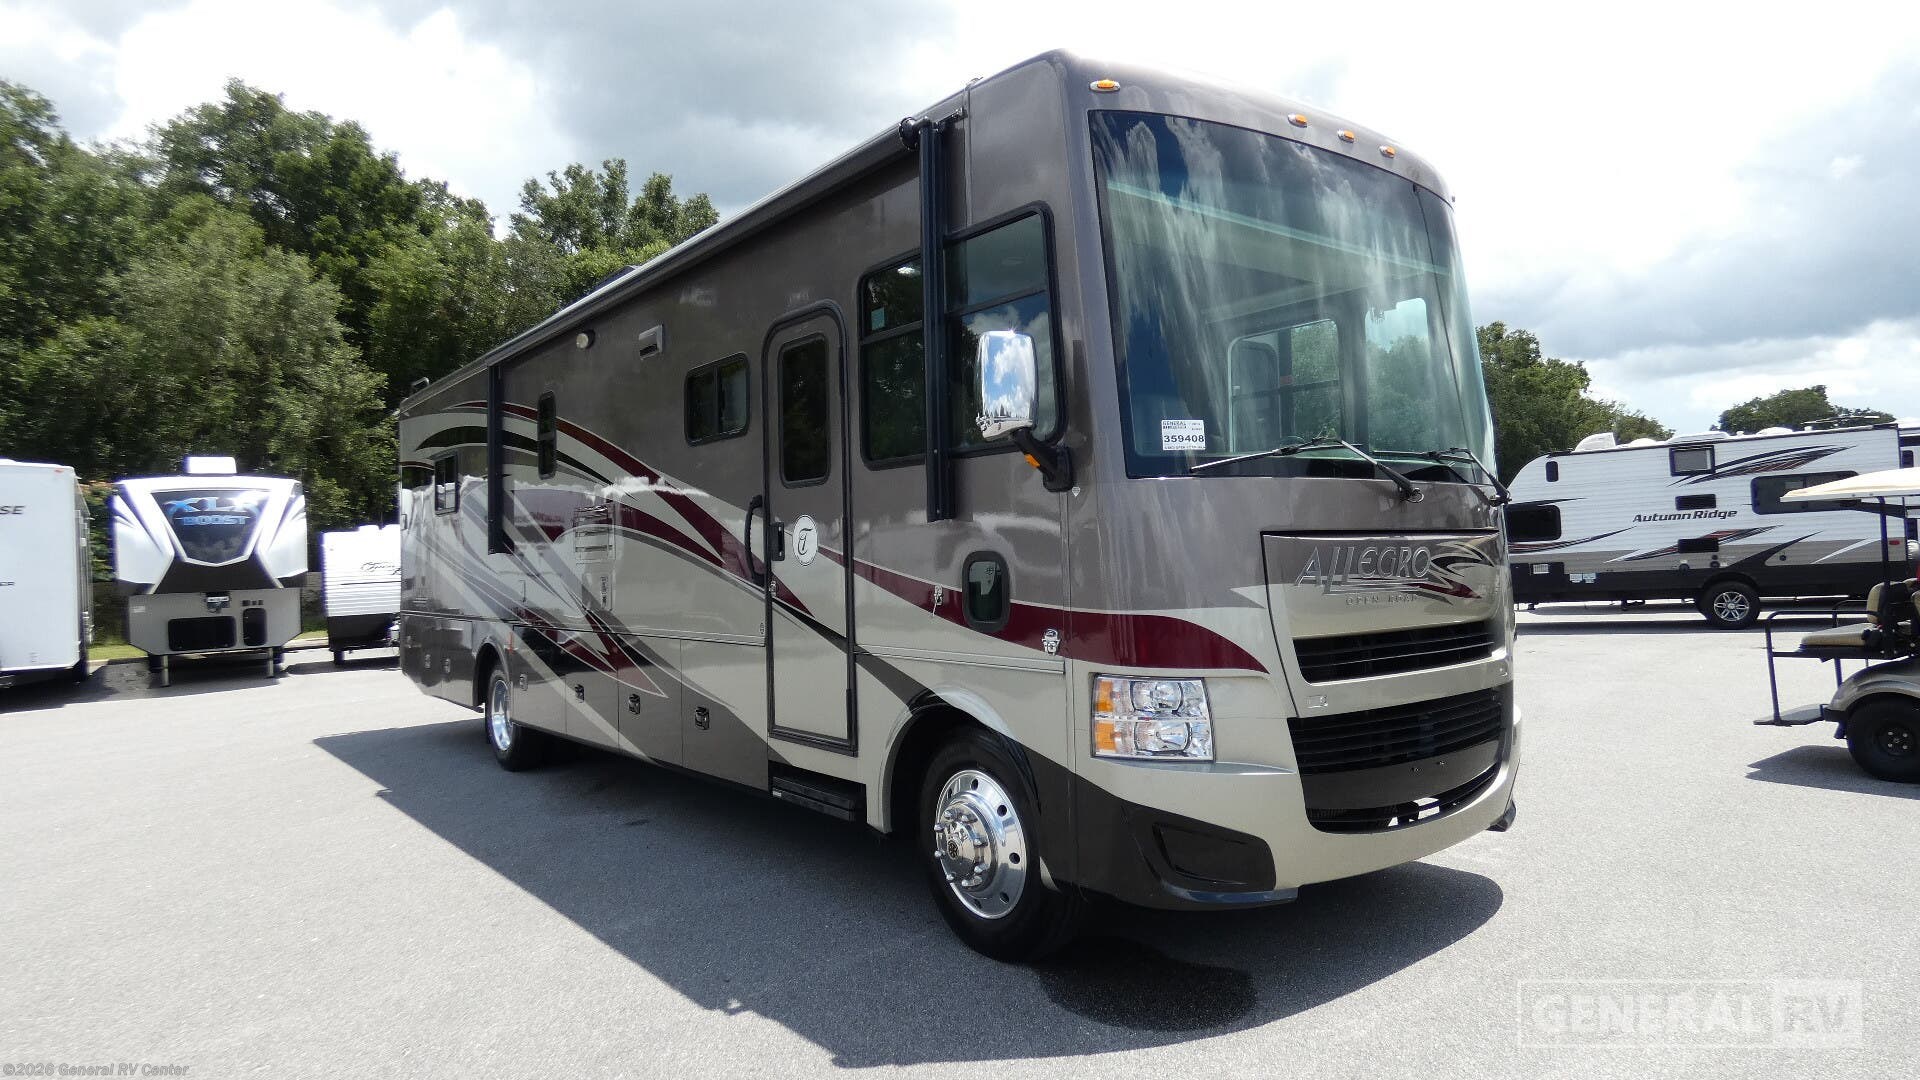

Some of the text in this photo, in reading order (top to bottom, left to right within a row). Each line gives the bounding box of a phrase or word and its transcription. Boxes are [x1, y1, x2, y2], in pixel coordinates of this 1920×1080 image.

[1163, 434, 1205, 443] 359408
[174, 515, 251, 526] BOOST
[1633, 509, 1738, 523] Autumn Ridge
[1294, 546, 1431, 596] ALLEGRO
